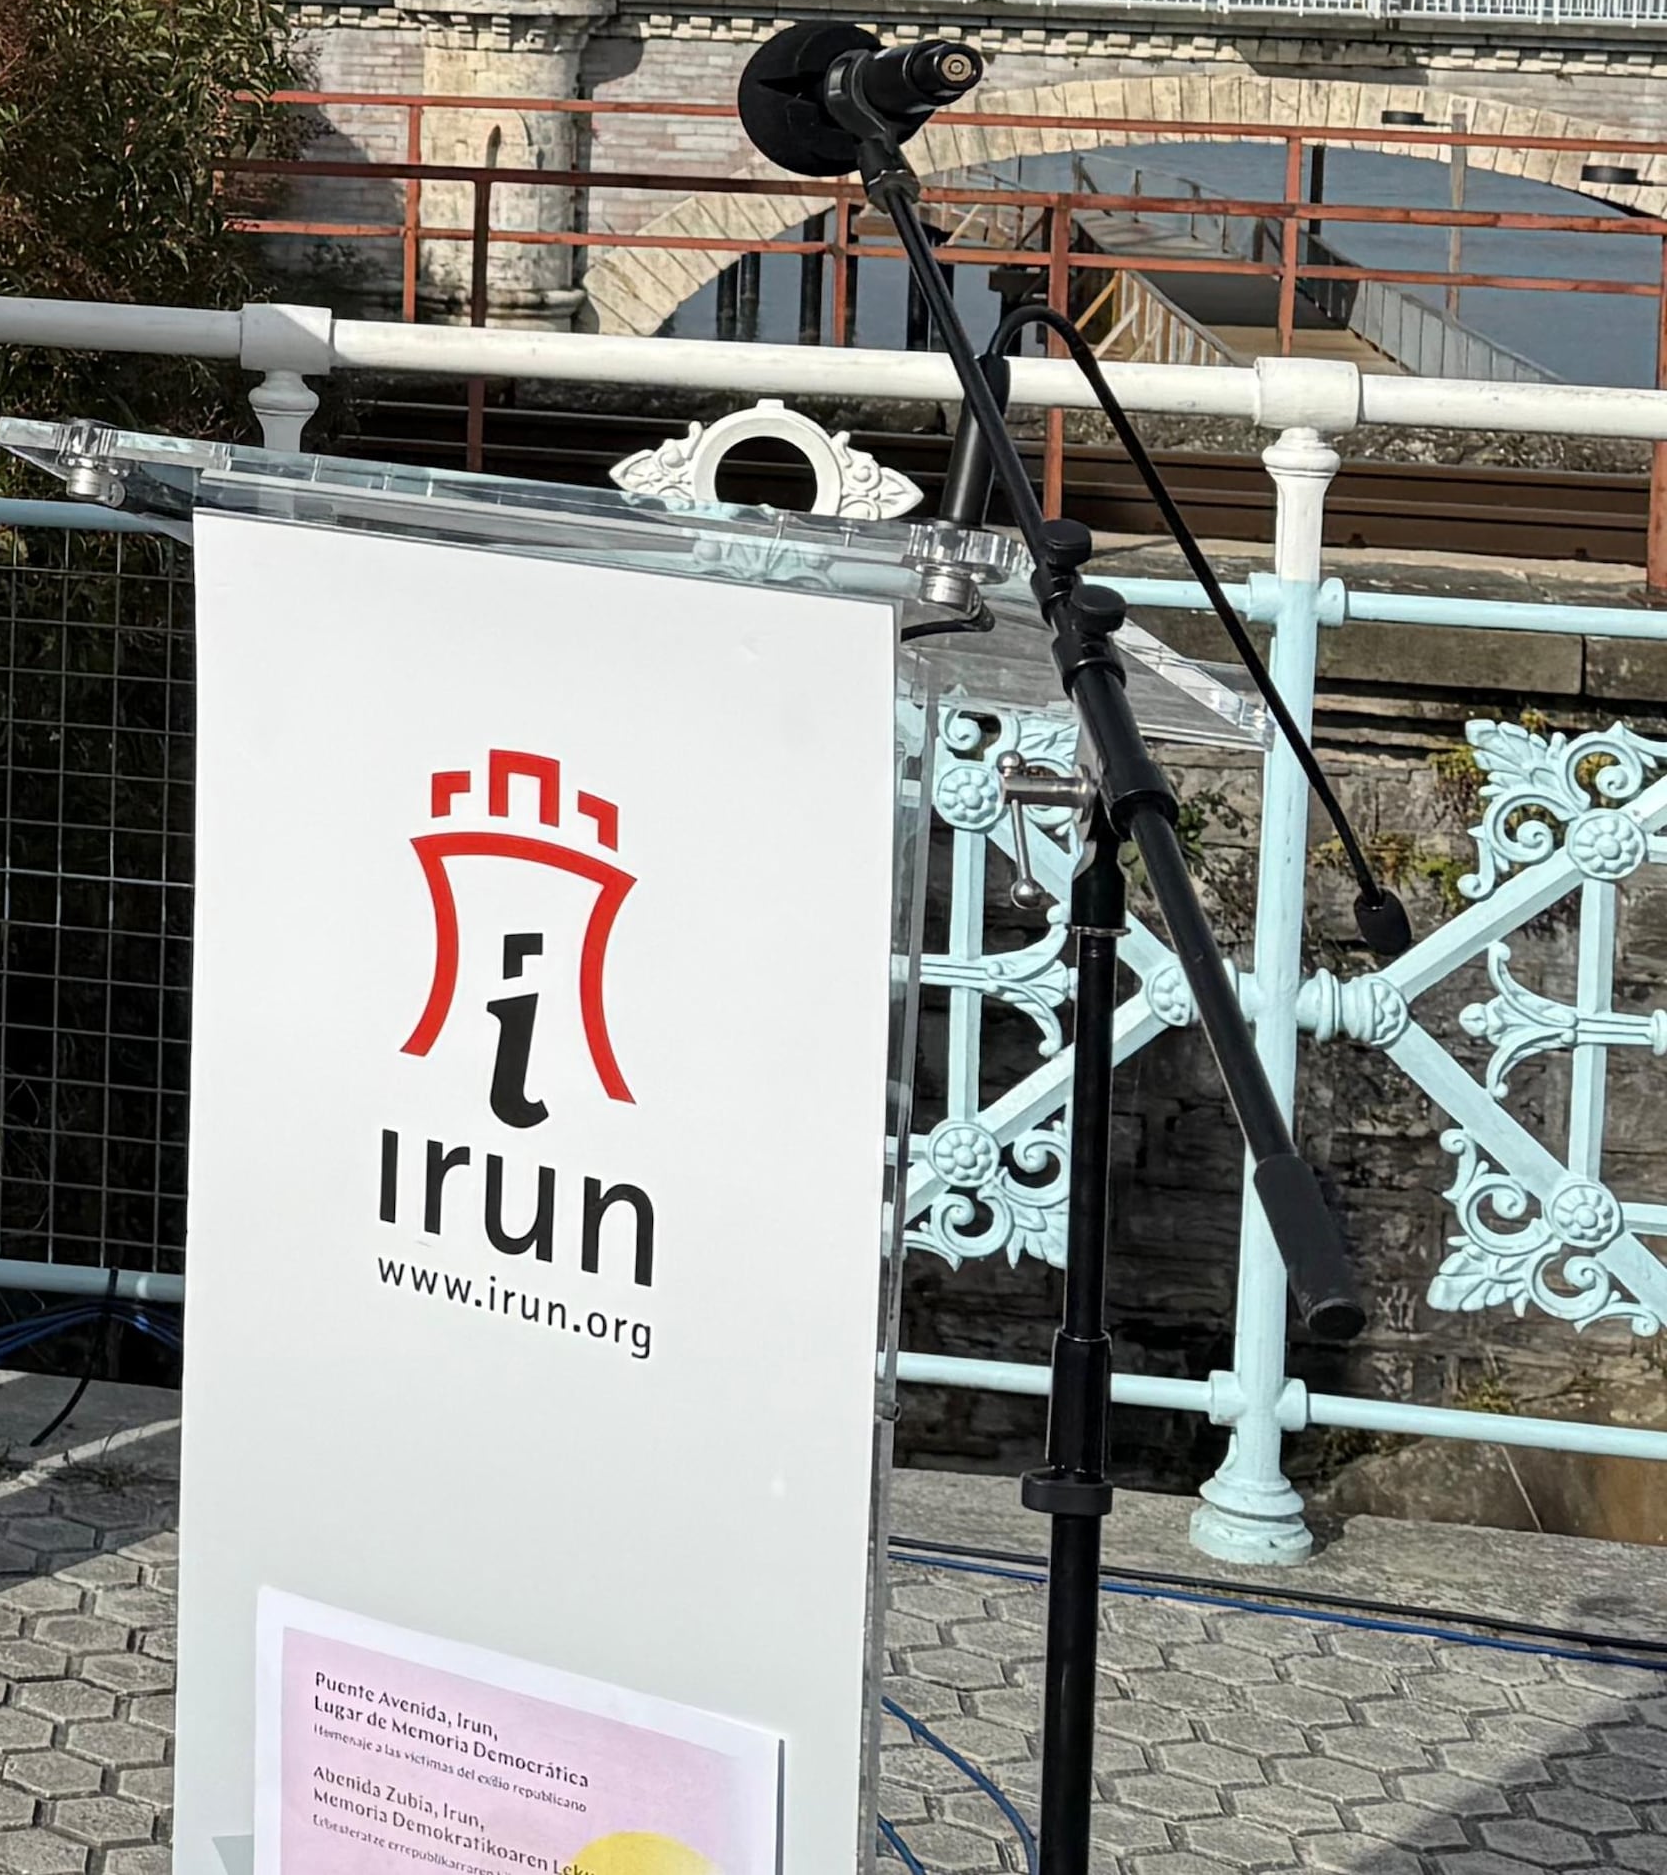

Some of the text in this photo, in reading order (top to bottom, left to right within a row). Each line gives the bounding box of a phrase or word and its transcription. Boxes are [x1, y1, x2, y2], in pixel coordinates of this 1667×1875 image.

[378, 1256, 651, 1359] www.irun.org
[314, 1695, 589, 1788] Lugar de Memoria Democrática
[316, 1671, 498, 1741] Puente Avenida, Irun,
[313, 1766, 485, 1832] Abenida Zubia, Irun,
[314, 1723, 372, 1751] Homenaje
[375, 1744, 382, 1753] a
[385, 1744, 401, 1759] las
[457, 1766, 475, 1780] del
[513, 1782, 587, 1813] republicano
[313, 1787, 387, 1823] Memoria
[393, 1811, 548, 1872] Demokratikoaren
